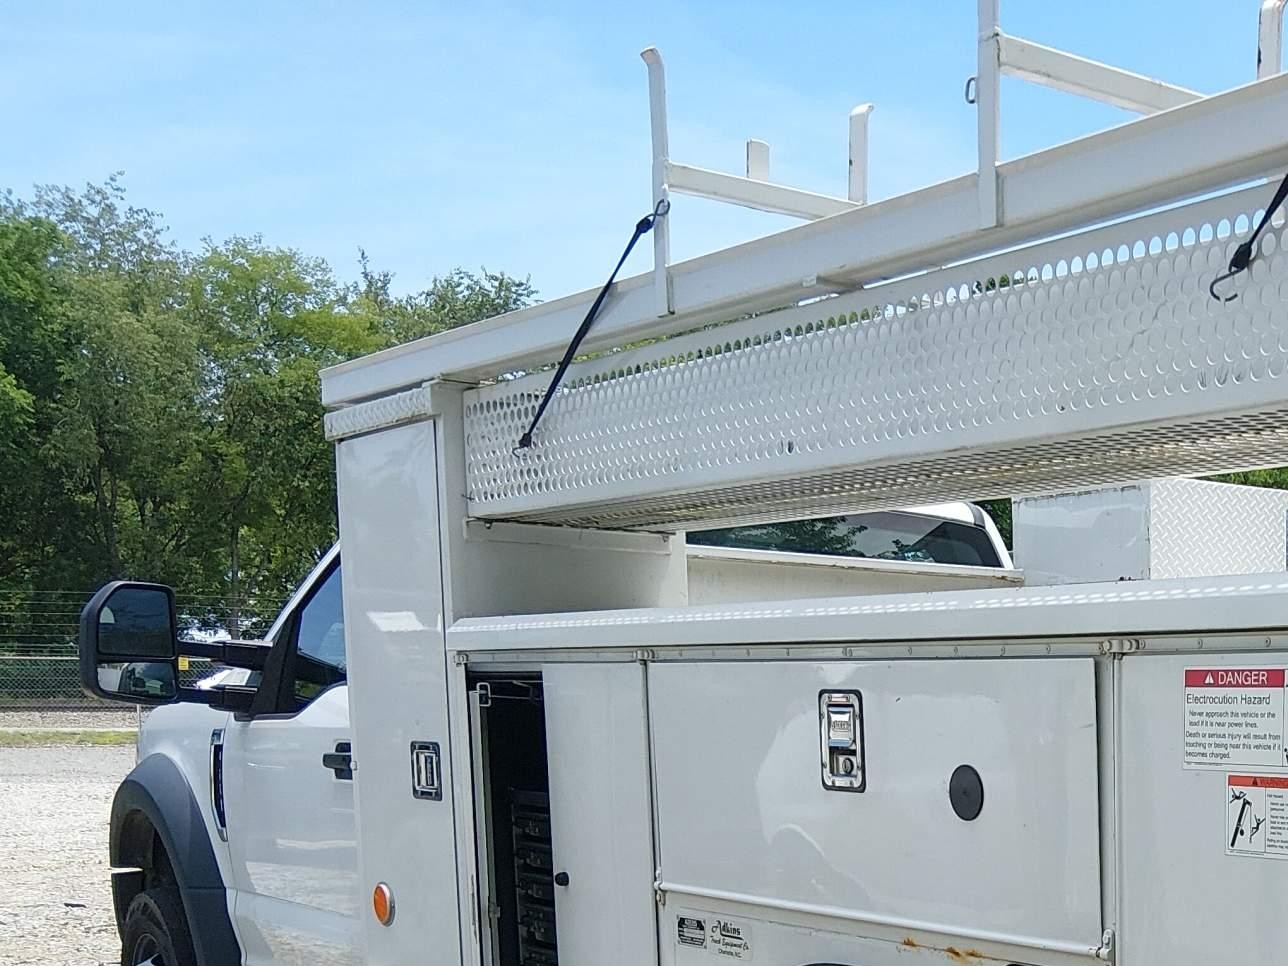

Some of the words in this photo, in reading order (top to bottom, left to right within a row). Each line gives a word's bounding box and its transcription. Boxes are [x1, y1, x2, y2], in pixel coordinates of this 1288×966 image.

[1218, 671, 1268, 685] DANGER
[1186, 693, 1238, 705] Electrocution
[1240, 693, 1271, 705] Hazard
[1205, 711, 1229, 719] approach
[1214, 742, 1228, 750] being
